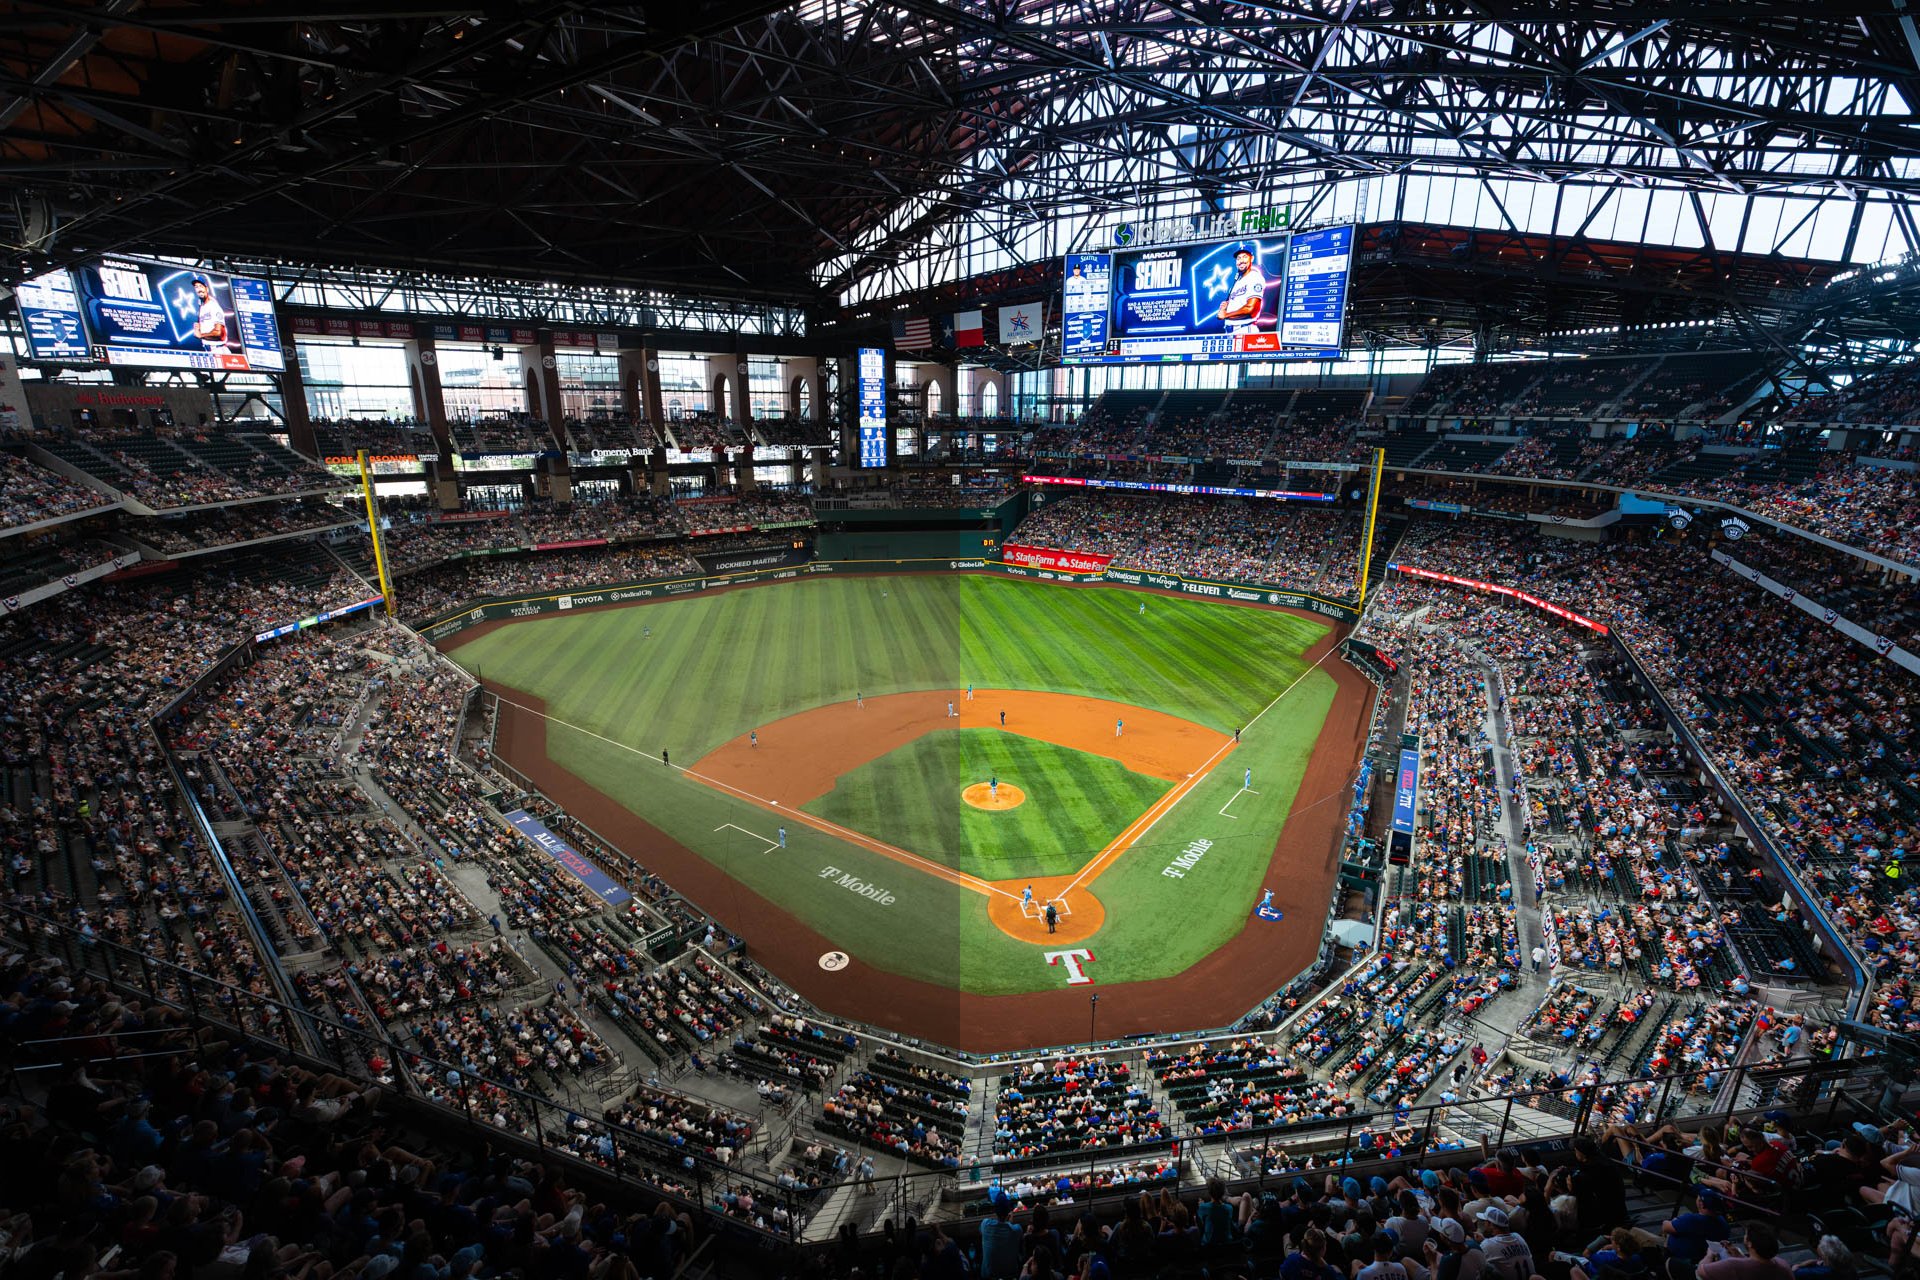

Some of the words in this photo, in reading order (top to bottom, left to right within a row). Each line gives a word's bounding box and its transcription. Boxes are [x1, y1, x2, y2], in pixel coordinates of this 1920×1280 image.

[1138, 223, 1195, 243] Globe
[1200, 213, 1238, 236] Life
[1241, 205, 1291, 231] Field
[1142, 250, 1177, 260] MARCUS
[102, 260, 140, 271] MARCUS
[1135, 258, 1183, 290] SEMIEN
[295, 318, 316, 327] 1996
[360, 322, 378, 330] 1999
[390, 322, 409, 332] 2010
[434, 325, 452, 334] 2010
[464, 327, 480, 335] 2011
[490, 328, 505, 336] 2011
[544, 358, 554, 366] 26
[632, 448, 654, 456] Bank
[691, 446, 714, 454] Coca-Cola
[724, 445, 745, 453] Coca-Cola
[324, 456, 353, 464] CORE
[1721, 519, 1732, 528] JACK
[716, 560, 751, 570] LOCKHEED
[752, 557, 778, 566] MARTIN
[1114, 572, 1141, 581] National
[1156, 576, 1178, 588] Kroger
[620, 591, 641, 599] Medical
[642, 589, 653, 597] City
[572, 596, 603, 605] TOYOTA
[510, 605, 541, 613] ESTRELLA
[470, 609, 484, 620] UTA
[1402, 769, 1414, 789] TEXAS
[1400, 796, 1412, 809] ALL
[534, 832, 557, 848] ALL
[557, 850, 593, 876] TEXAS
[1171, 838, 1214, 870] Mobile
[832, 873, 896, 906] Mobile
[648, 930, 674, 945] TOYOTA
[1043, 948, 1096, 987] T
[1548, 1140, 1564, 1152] 217
